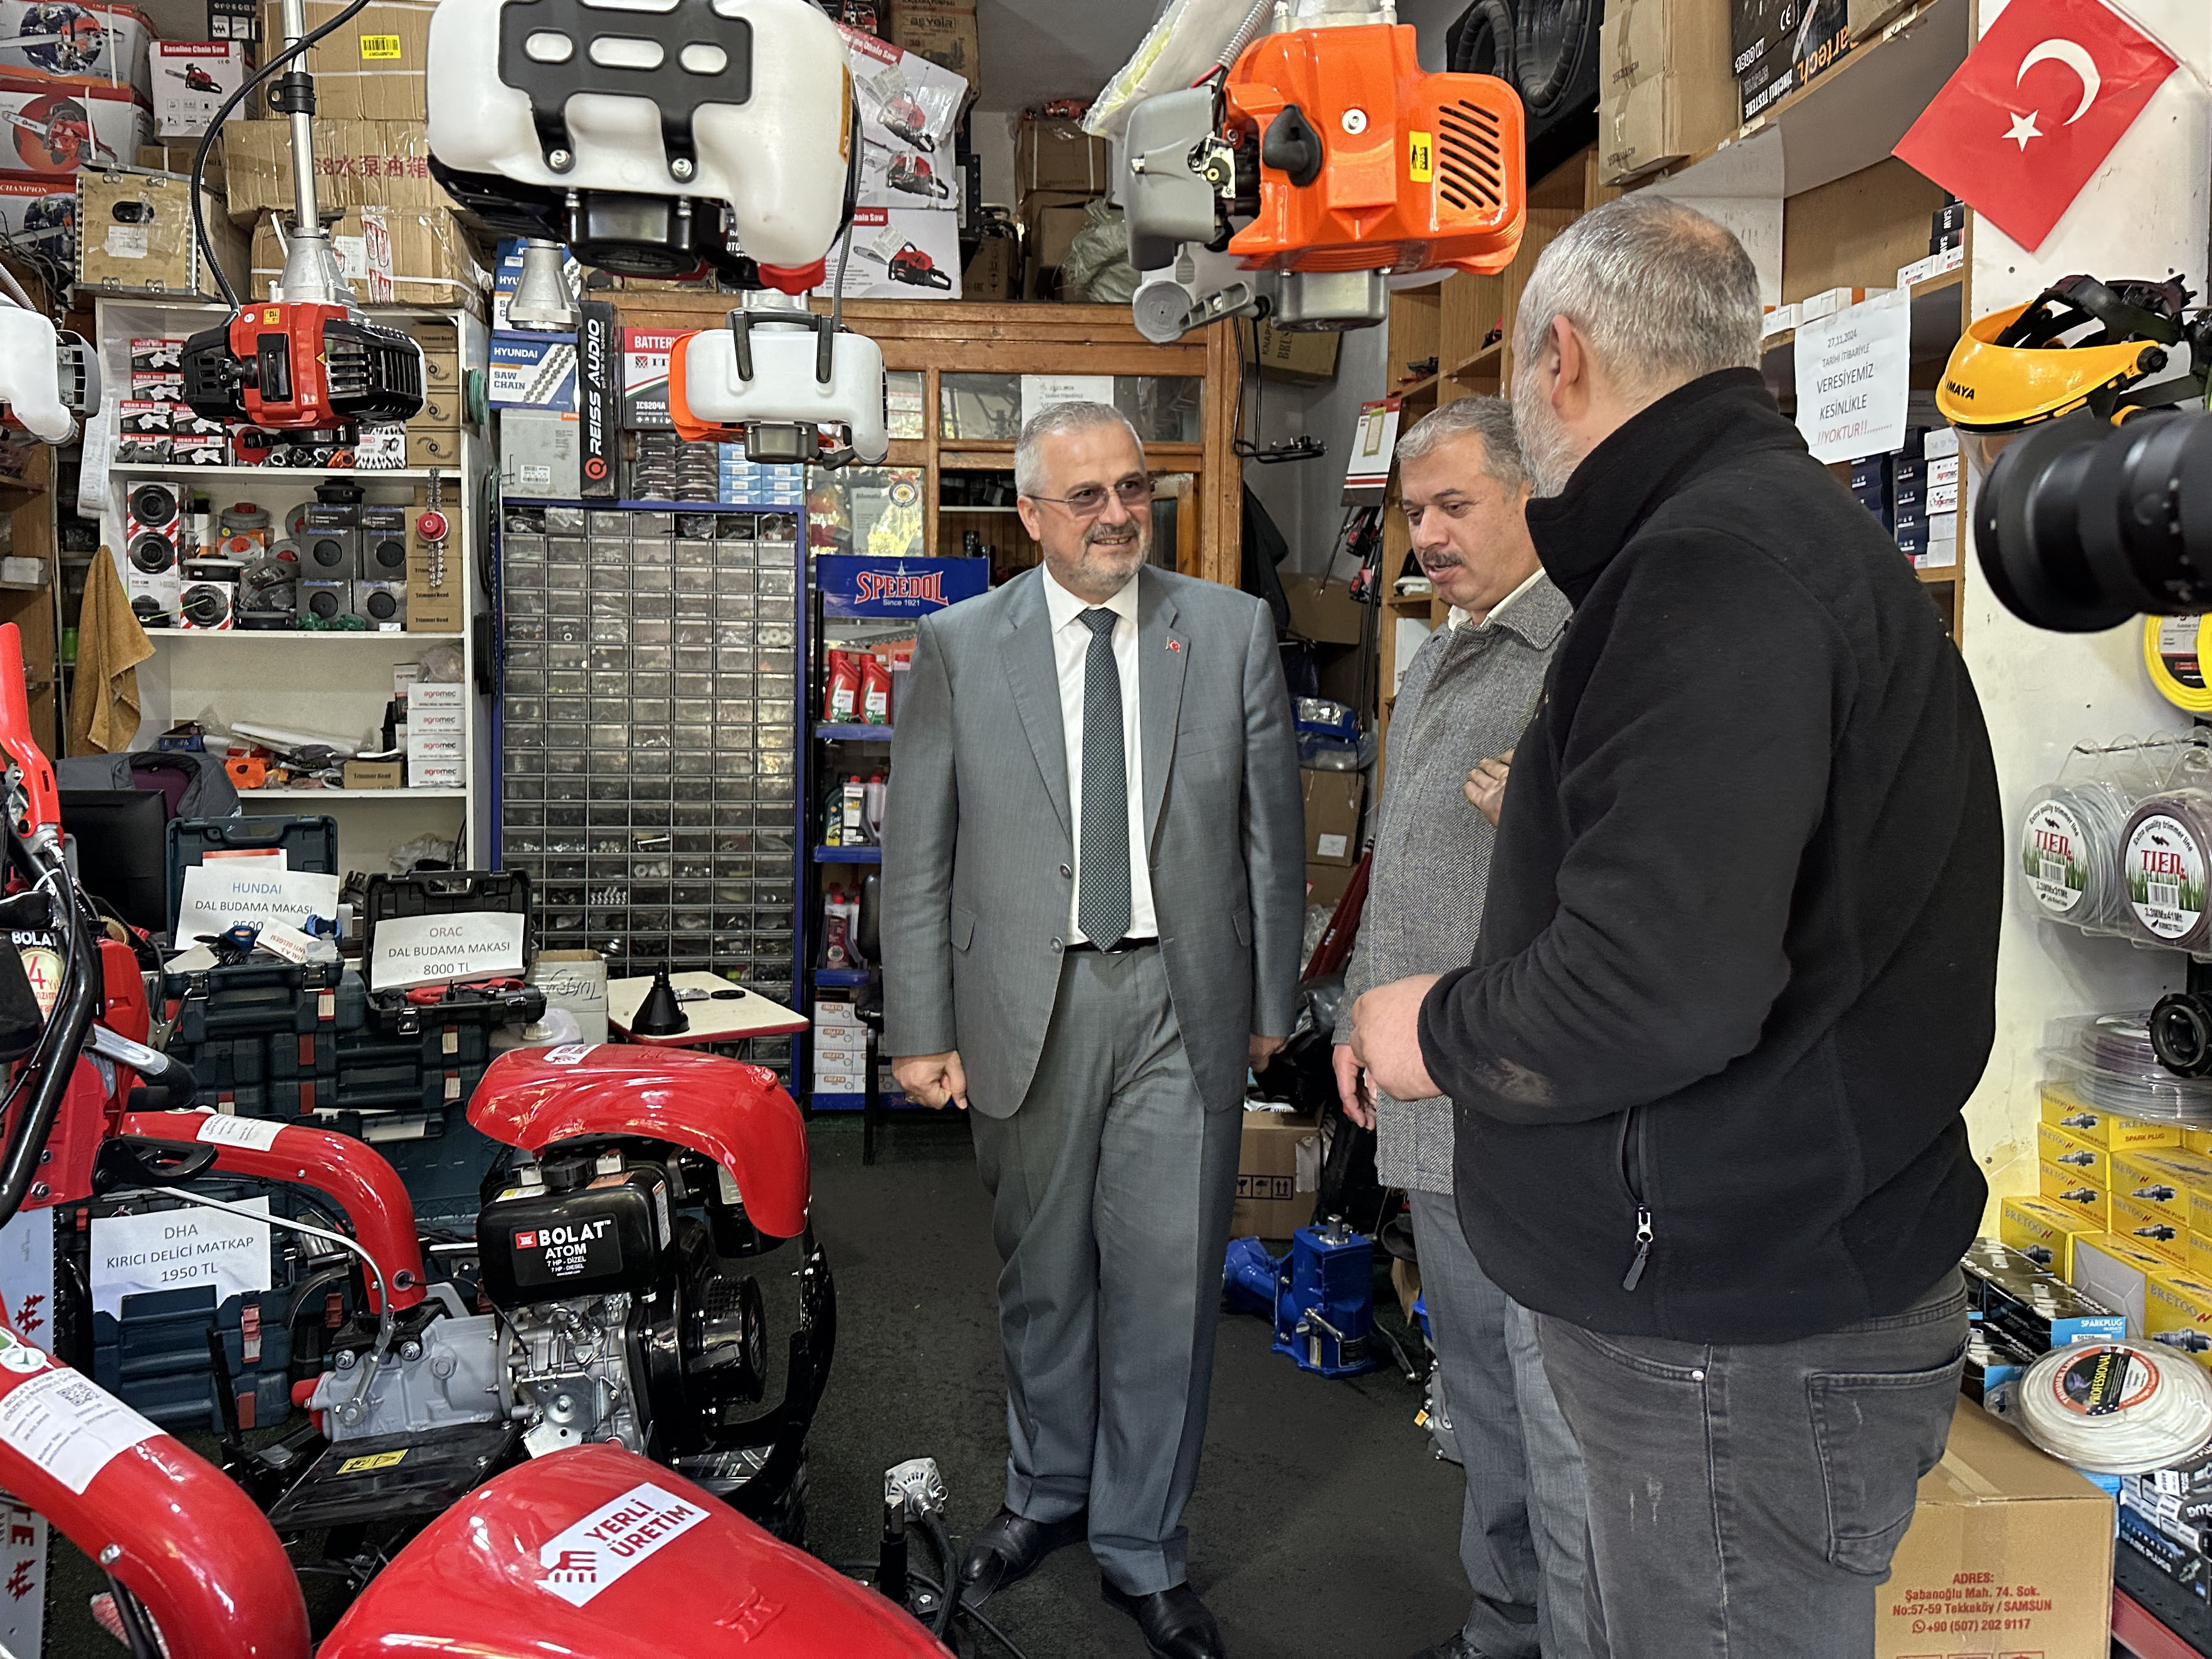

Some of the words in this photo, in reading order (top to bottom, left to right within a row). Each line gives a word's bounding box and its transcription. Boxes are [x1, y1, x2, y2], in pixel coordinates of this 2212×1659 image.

[164, 45, 192, 53] Gasoline
[192, 45, 211, 53] Chain
[853, 213, 868, 222] hain
[870, 213, 884, 222] Saw
[1944, 209, 1952, 229] SAW
[494, 347, 538, 359] HYUNDAI
[588, 319, 601, 388] AUDIO
[493, 371, 517, 380] SAW
[1817, 361, 1874, 394] VERESİYEMİZ
[493, 381, 526, 390] CHAIN
[1820, 394, 1868, 421] KESİNLİKLE
[589, 389, 602, 456] REISS
[855, 571, 949, 606] SPEEDOL
[424, 690, 456, 698] agromec
[423, 716, 455, 724] agromec
[424, 768, 457, 776] agromec
[233, 882, 282, 894] HUNDAI
[195, 900, 217, 910] DAL
[220, 902, 268, 912] BUDAMA
[271, 903, 312, 915] MAKASI
[429, 927, 463, 938] ORAC
[388, 947, 411, 958] DAL
[414, 945, 465, 956] BUDAMA
[468, 942, 510, 954] MAKASI
[28, 956, 46, 989] 4
[423, 964, 454, 975] 8000
[458, 962, 471, 973] TL
[164, 1224, 199, 1240] DHA
[107, 1253, 145, 1268] KIRICI
[151, 1243, 192, 1263] DELİCİ
[197, 1237, 254, 1255] MATKAP
[545, 1243, 587, 1260] ATOM
[567, 1256, 587, 1264] DİZEL
[161, 1265, 198, 1282] 1950
[201, 1262, 219, 1275] TL
[2080, 1319, 2123, 1328] SPARKPLUG
[2090, 1354, 2112, 1405] PROFESSIONAL
[584, 1498, 655, 1541] YERLİ
[606, 1505, 695, 1557] ÜRETİM
[1952, 1572, 1994, 1584] ADRES:
[1905, 1588, 1962, 1603] Şabanoğlu
[1965, 1586, 1993, 1598] Mah.
[1996, 1586, 2013, 1597] 74.
[2016, 1586, 2040, 1597] Sok.
[1893, 1603, 1942, 1616] No:57-59
[2004, 1599, 2052, 1612] SAMSUN
[1926, 1621, 1947, 1631] +90
[1950, 1620, 1979, 1634] (507)
[1981, 1620, 2001, 1630] 202
[2004, 1618, 2031, 1630] 9117
